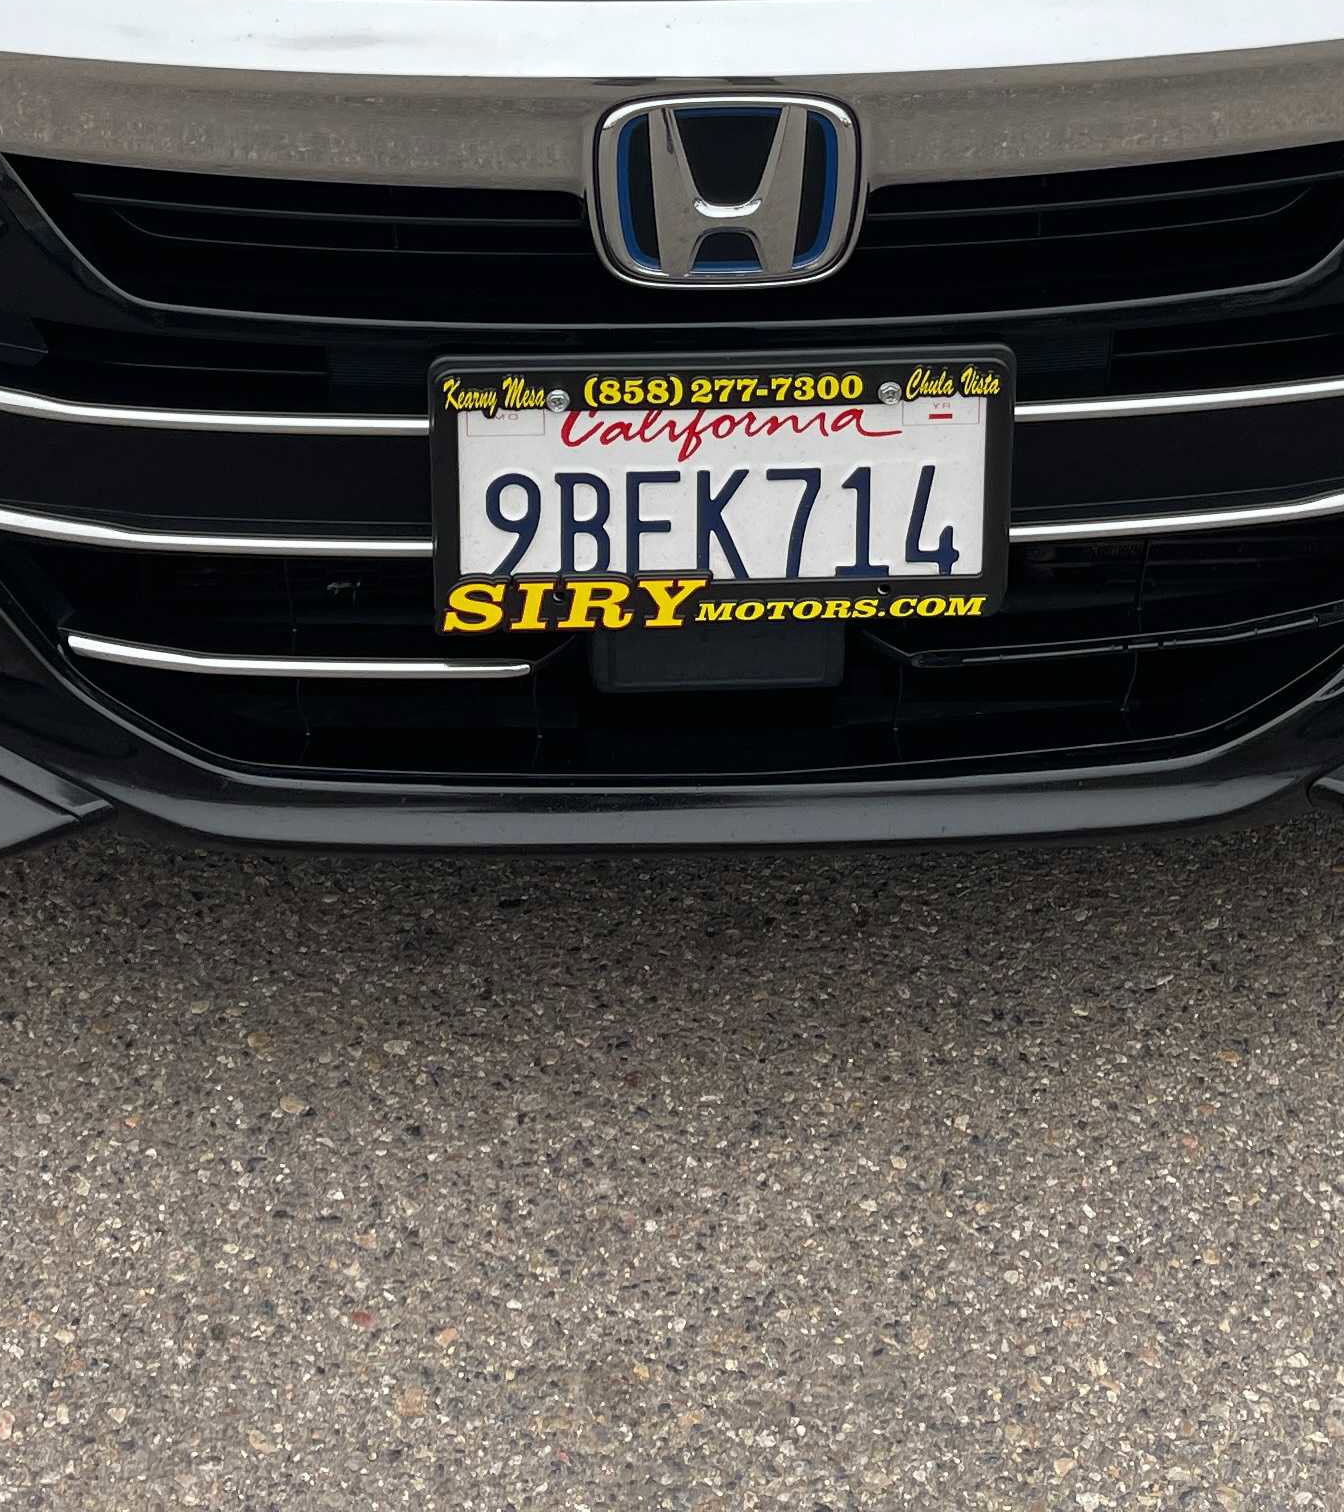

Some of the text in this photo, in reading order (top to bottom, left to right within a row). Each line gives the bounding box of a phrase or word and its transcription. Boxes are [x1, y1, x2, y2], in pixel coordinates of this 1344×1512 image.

[443, 376, 546, 414] Kearny Mesa
[583, 374, 863, 407] (858) 277-7300
[905, 366, 1000, 401] Chula Vista
[560, 408, 903, 463] California
[443, 578, 986, 634] SIRY MOTORS.COM
